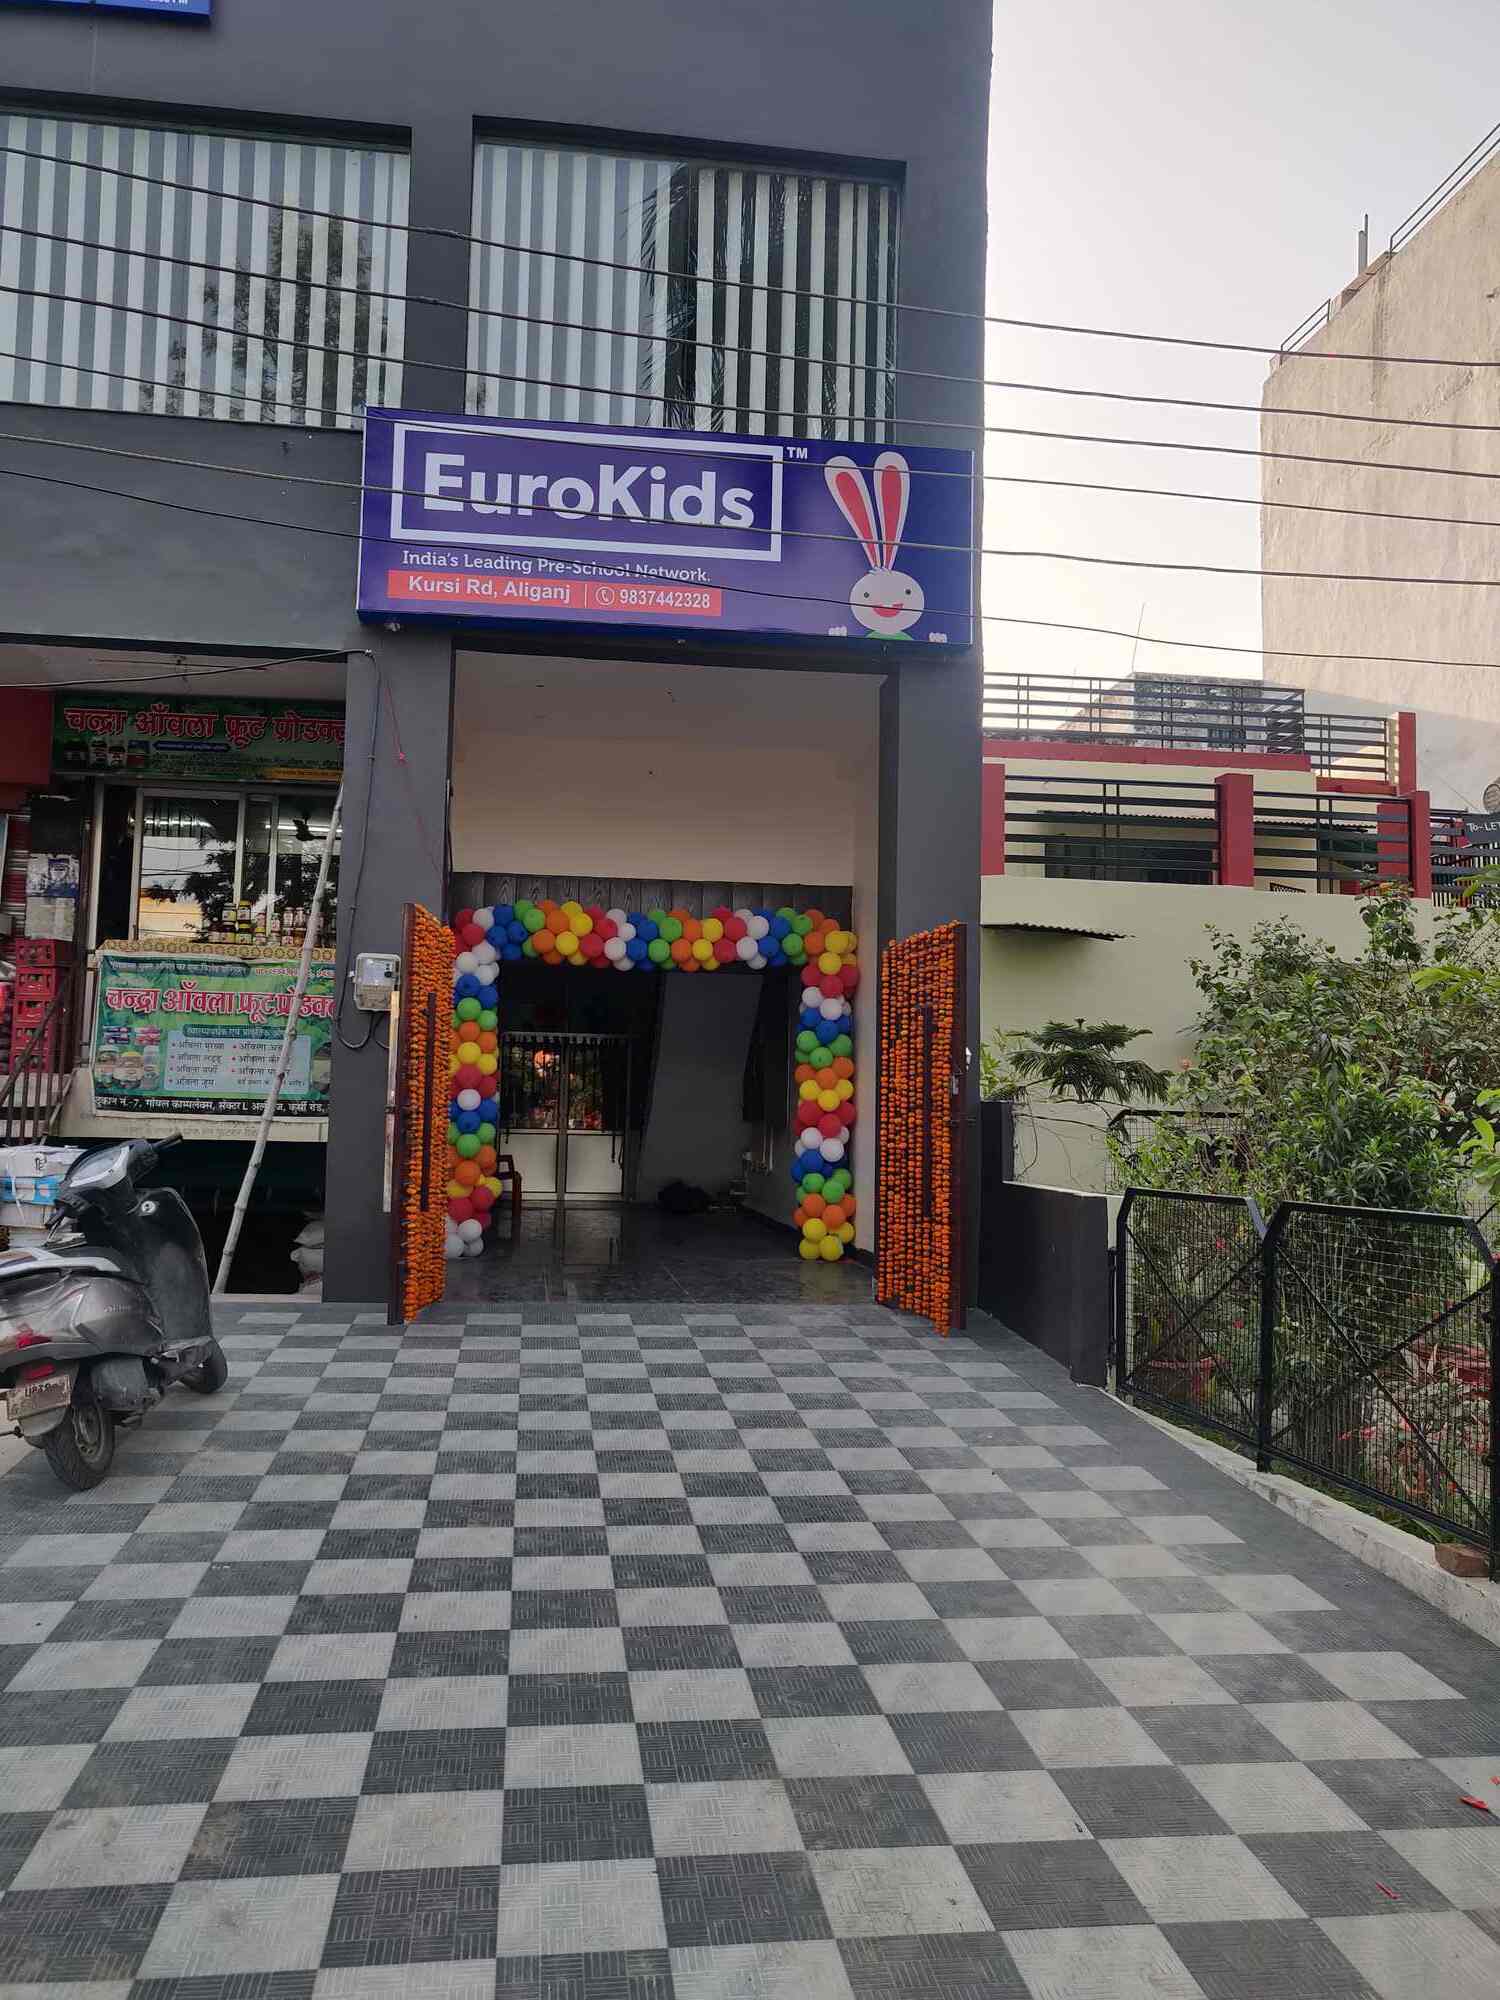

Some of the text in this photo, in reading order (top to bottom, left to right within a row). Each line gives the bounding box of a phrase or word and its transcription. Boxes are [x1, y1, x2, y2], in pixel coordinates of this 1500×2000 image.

[424, 446, 808, 529] EuroKids TM
[402, 550, 712, 582] India's Leading Pre-School Network.
[408, 575, 570, 604] Kursi Rd, Aliganj
[619, 588, 711, 609] 9837442328
